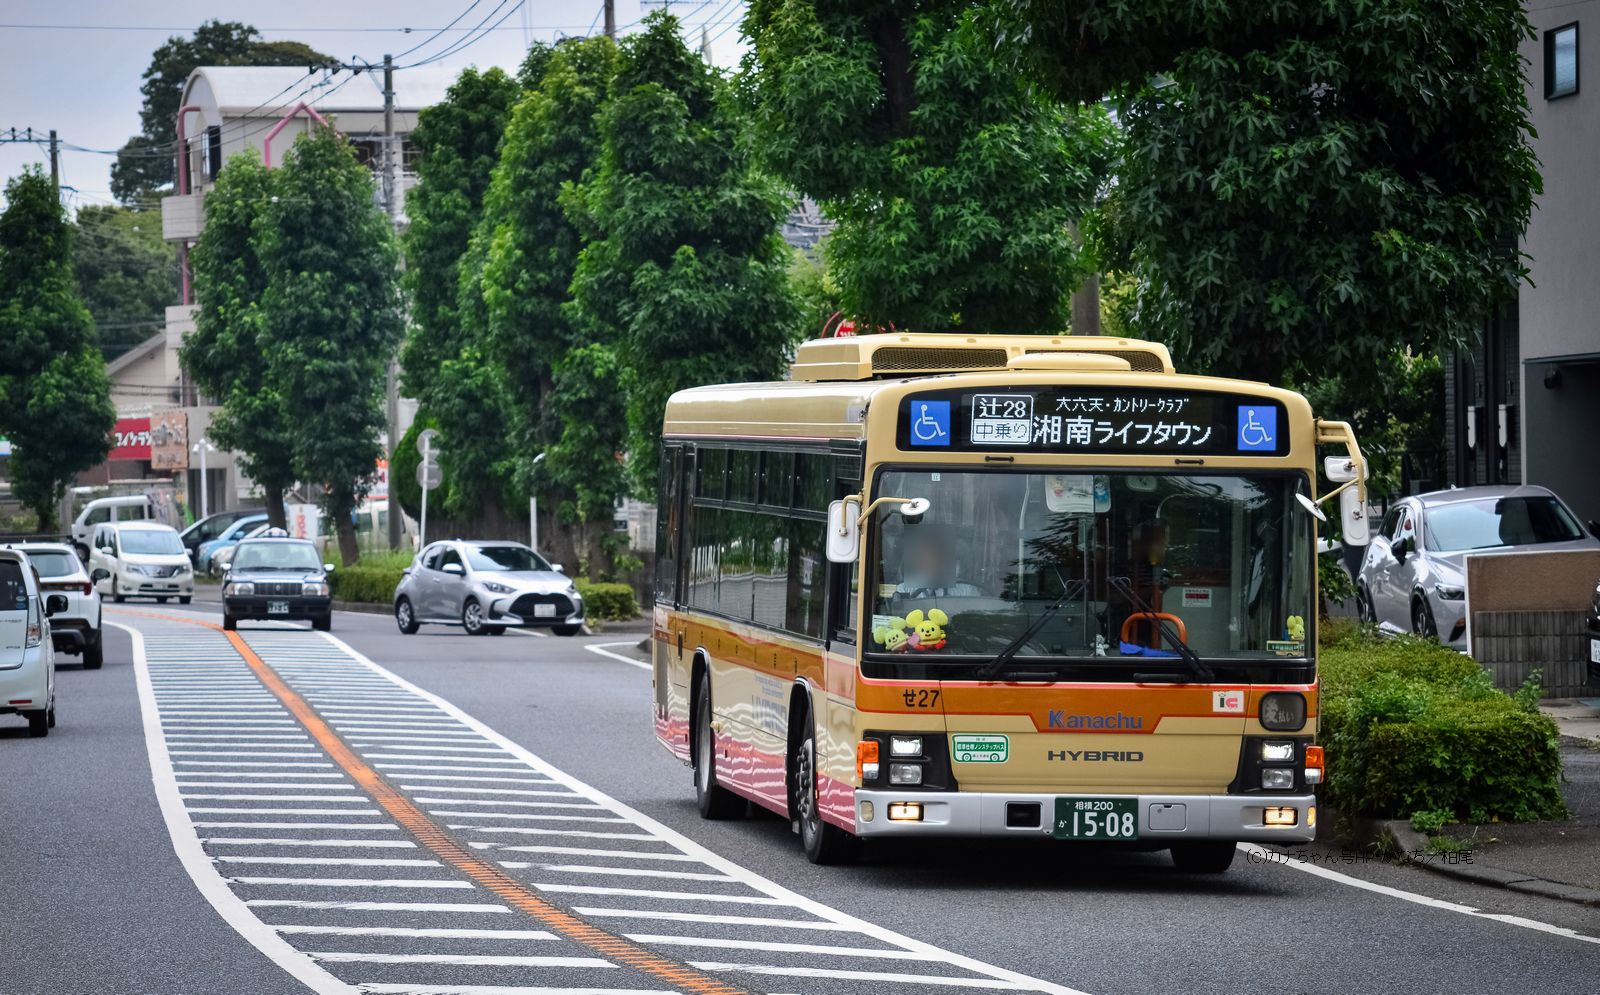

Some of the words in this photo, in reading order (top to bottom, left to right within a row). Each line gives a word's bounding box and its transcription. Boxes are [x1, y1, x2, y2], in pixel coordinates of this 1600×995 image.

[979, 397, 1026, 418] 辻28
[975, 422, 1027, 440] 中乗り
[1032, 414, 1212, 445] 湘南ライフタウン
[902, 688, 940, 708] せ27
[1048, 708, 1143, 729] Kanachu
[1047, 750, 1144, 762] HYBRID
[1075, 801, 1114, 811] 相模200
[1073, 811, 1134, 837] 15-08
